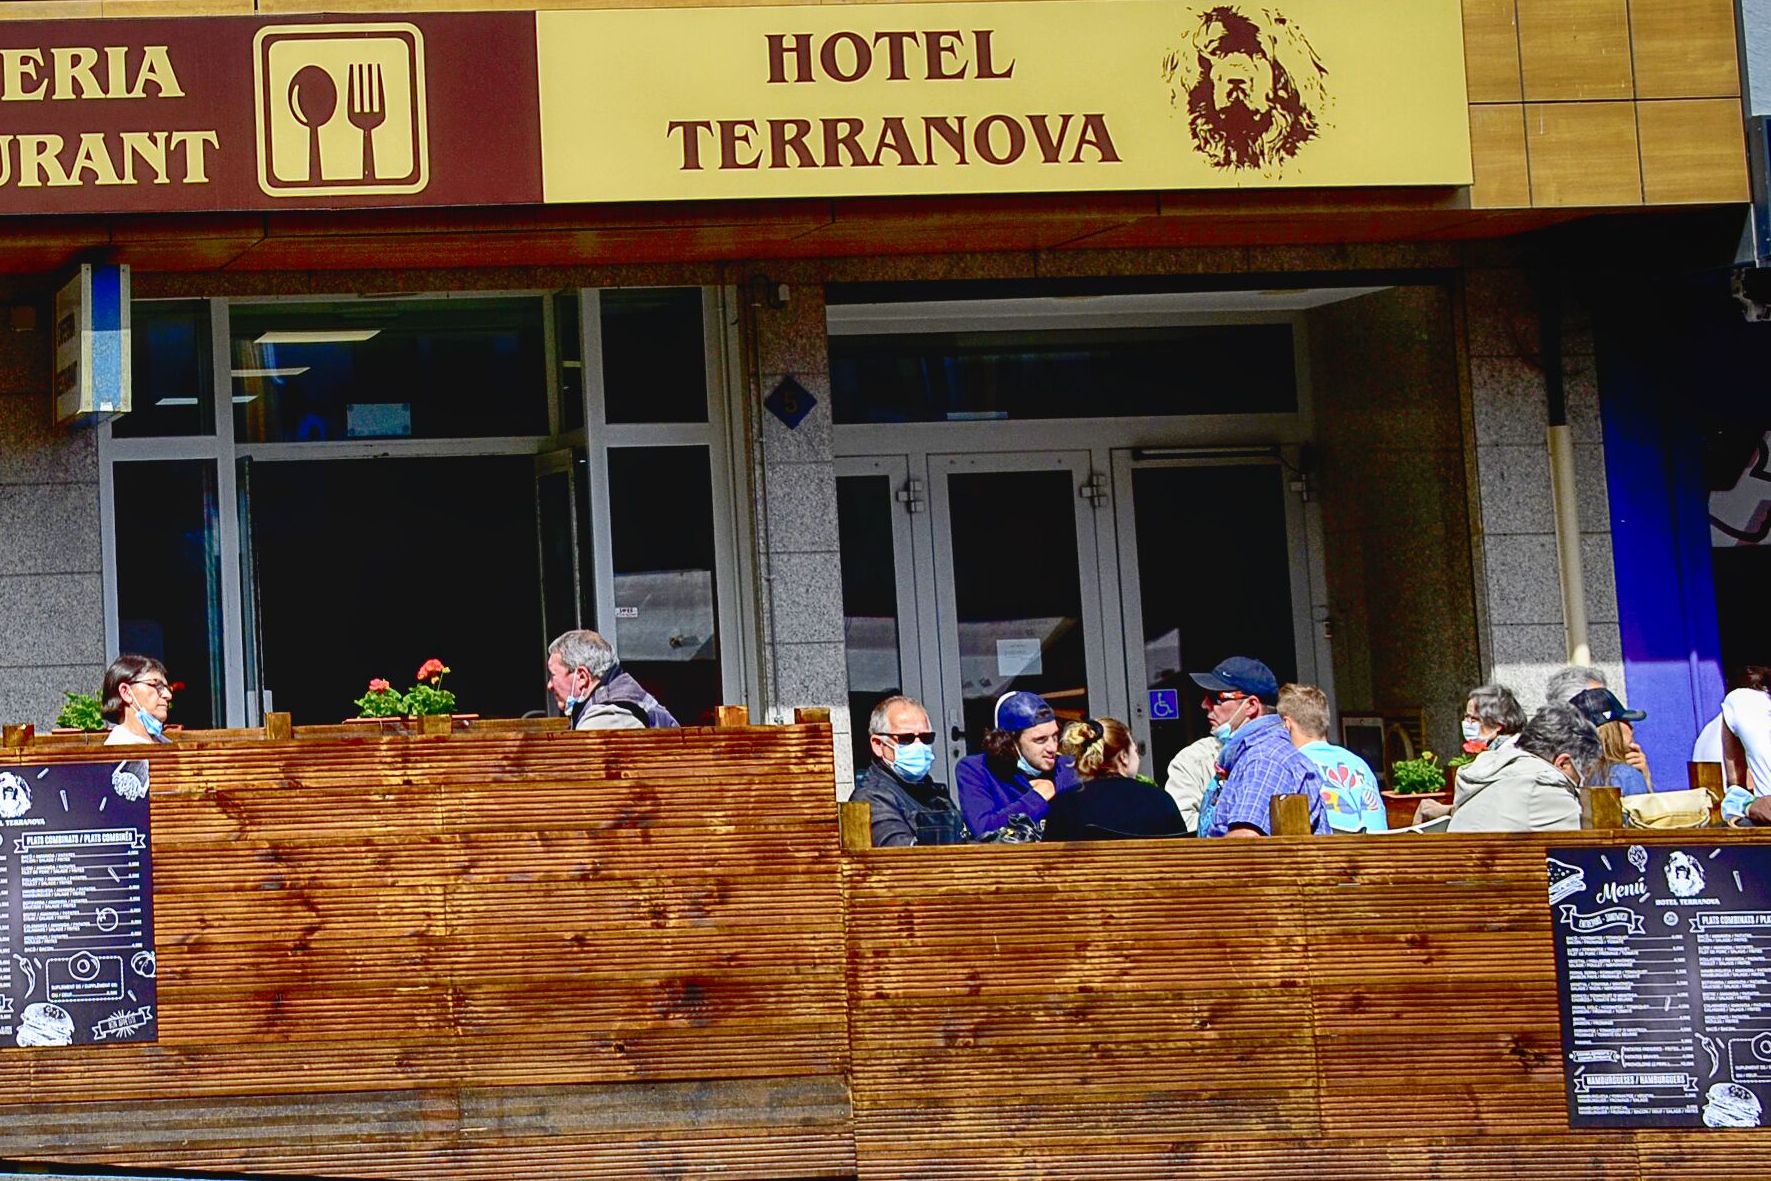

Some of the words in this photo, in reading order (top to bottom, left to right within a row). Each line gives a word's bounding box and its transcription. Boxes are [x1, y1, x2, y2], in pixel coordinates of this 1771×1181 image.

[764, 29, 1016, 85] HOTEL
[666, 113, 1123, 172] TERRANOVA
[26, 835, 44, 845] PLATS
[84, 833, 102, 844] PLATS
[1596, 876, 1648, 905] Menú
[1655, 898, 1678, 906] HOTEL
[1701, 915, 1720, 925] PLATS
